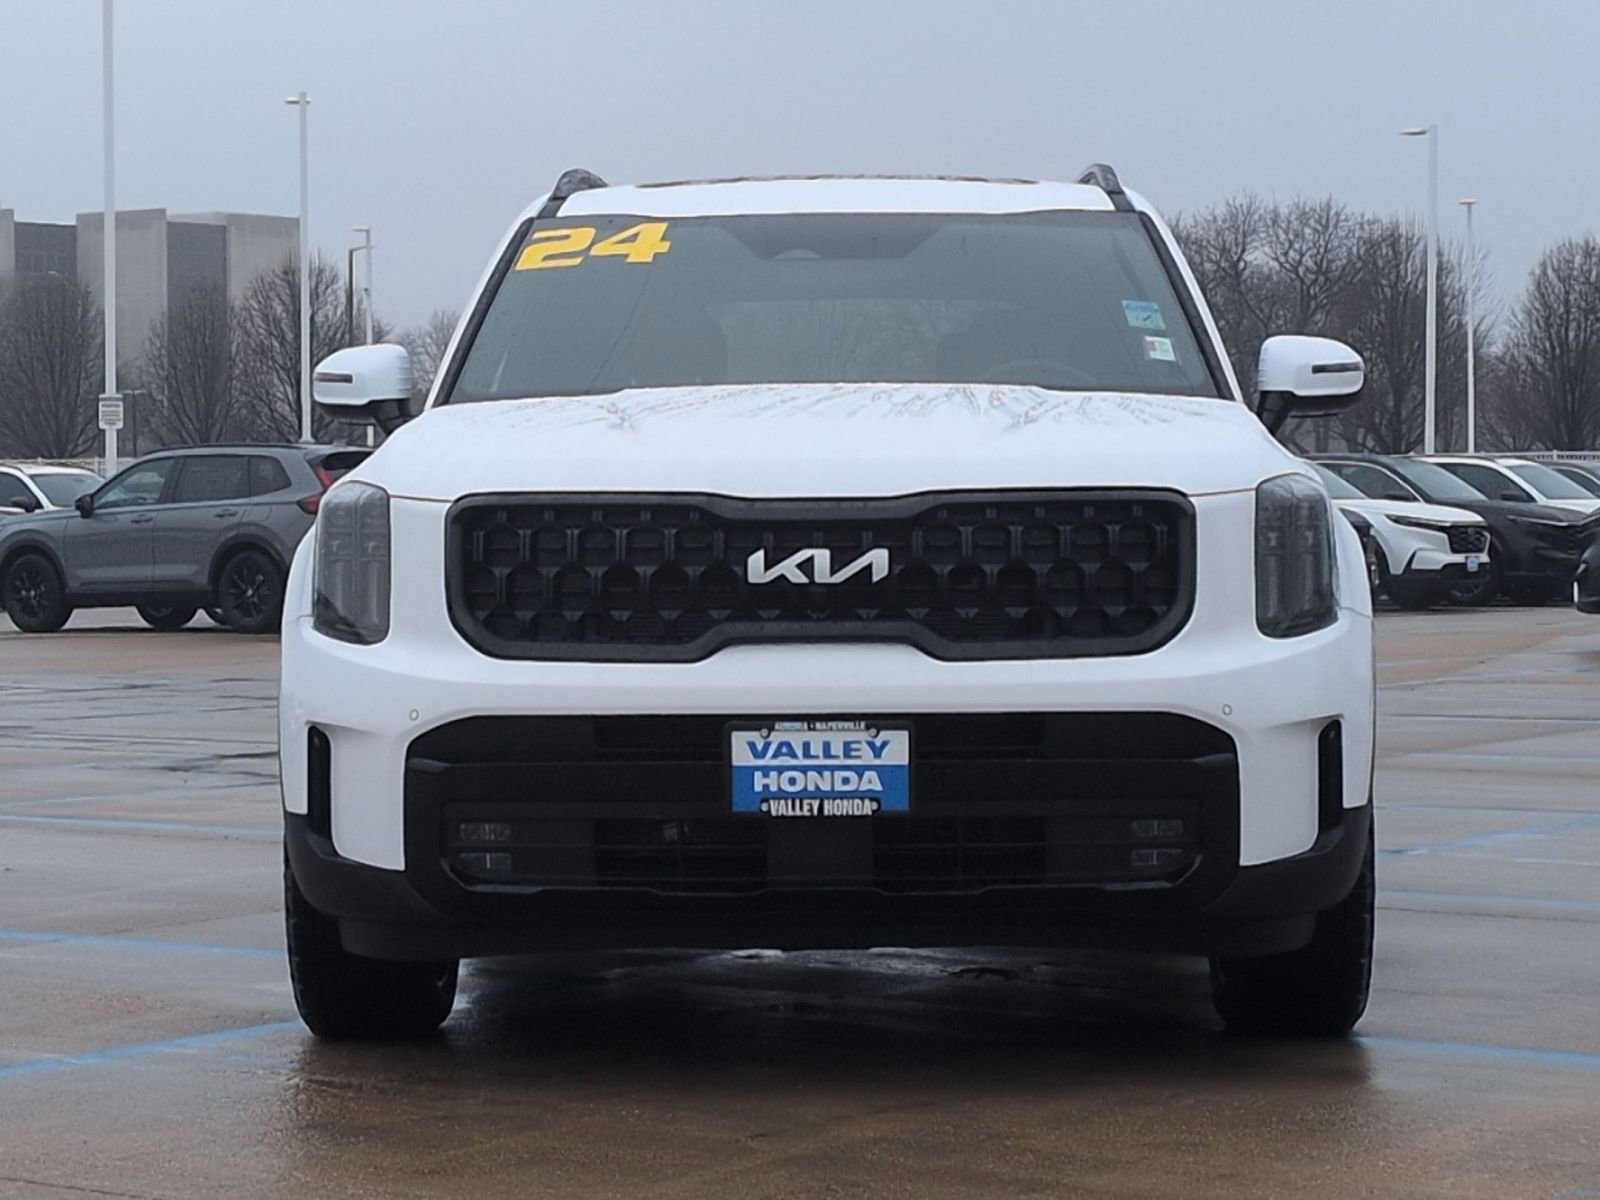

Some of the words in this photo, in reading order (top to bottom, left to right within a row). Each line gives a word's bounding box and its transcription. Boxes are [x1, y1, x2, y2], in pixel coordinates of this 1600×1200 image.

[515, 222, 671, 271] 24
[747, 548, 889, 584] KIA
[746, 740, 891, 760] VALLEY
[753, 770, 883, 792] HONDA
[769, 799, 820, 816] VALLEY
[823, 799, 872, 816] HONDA
